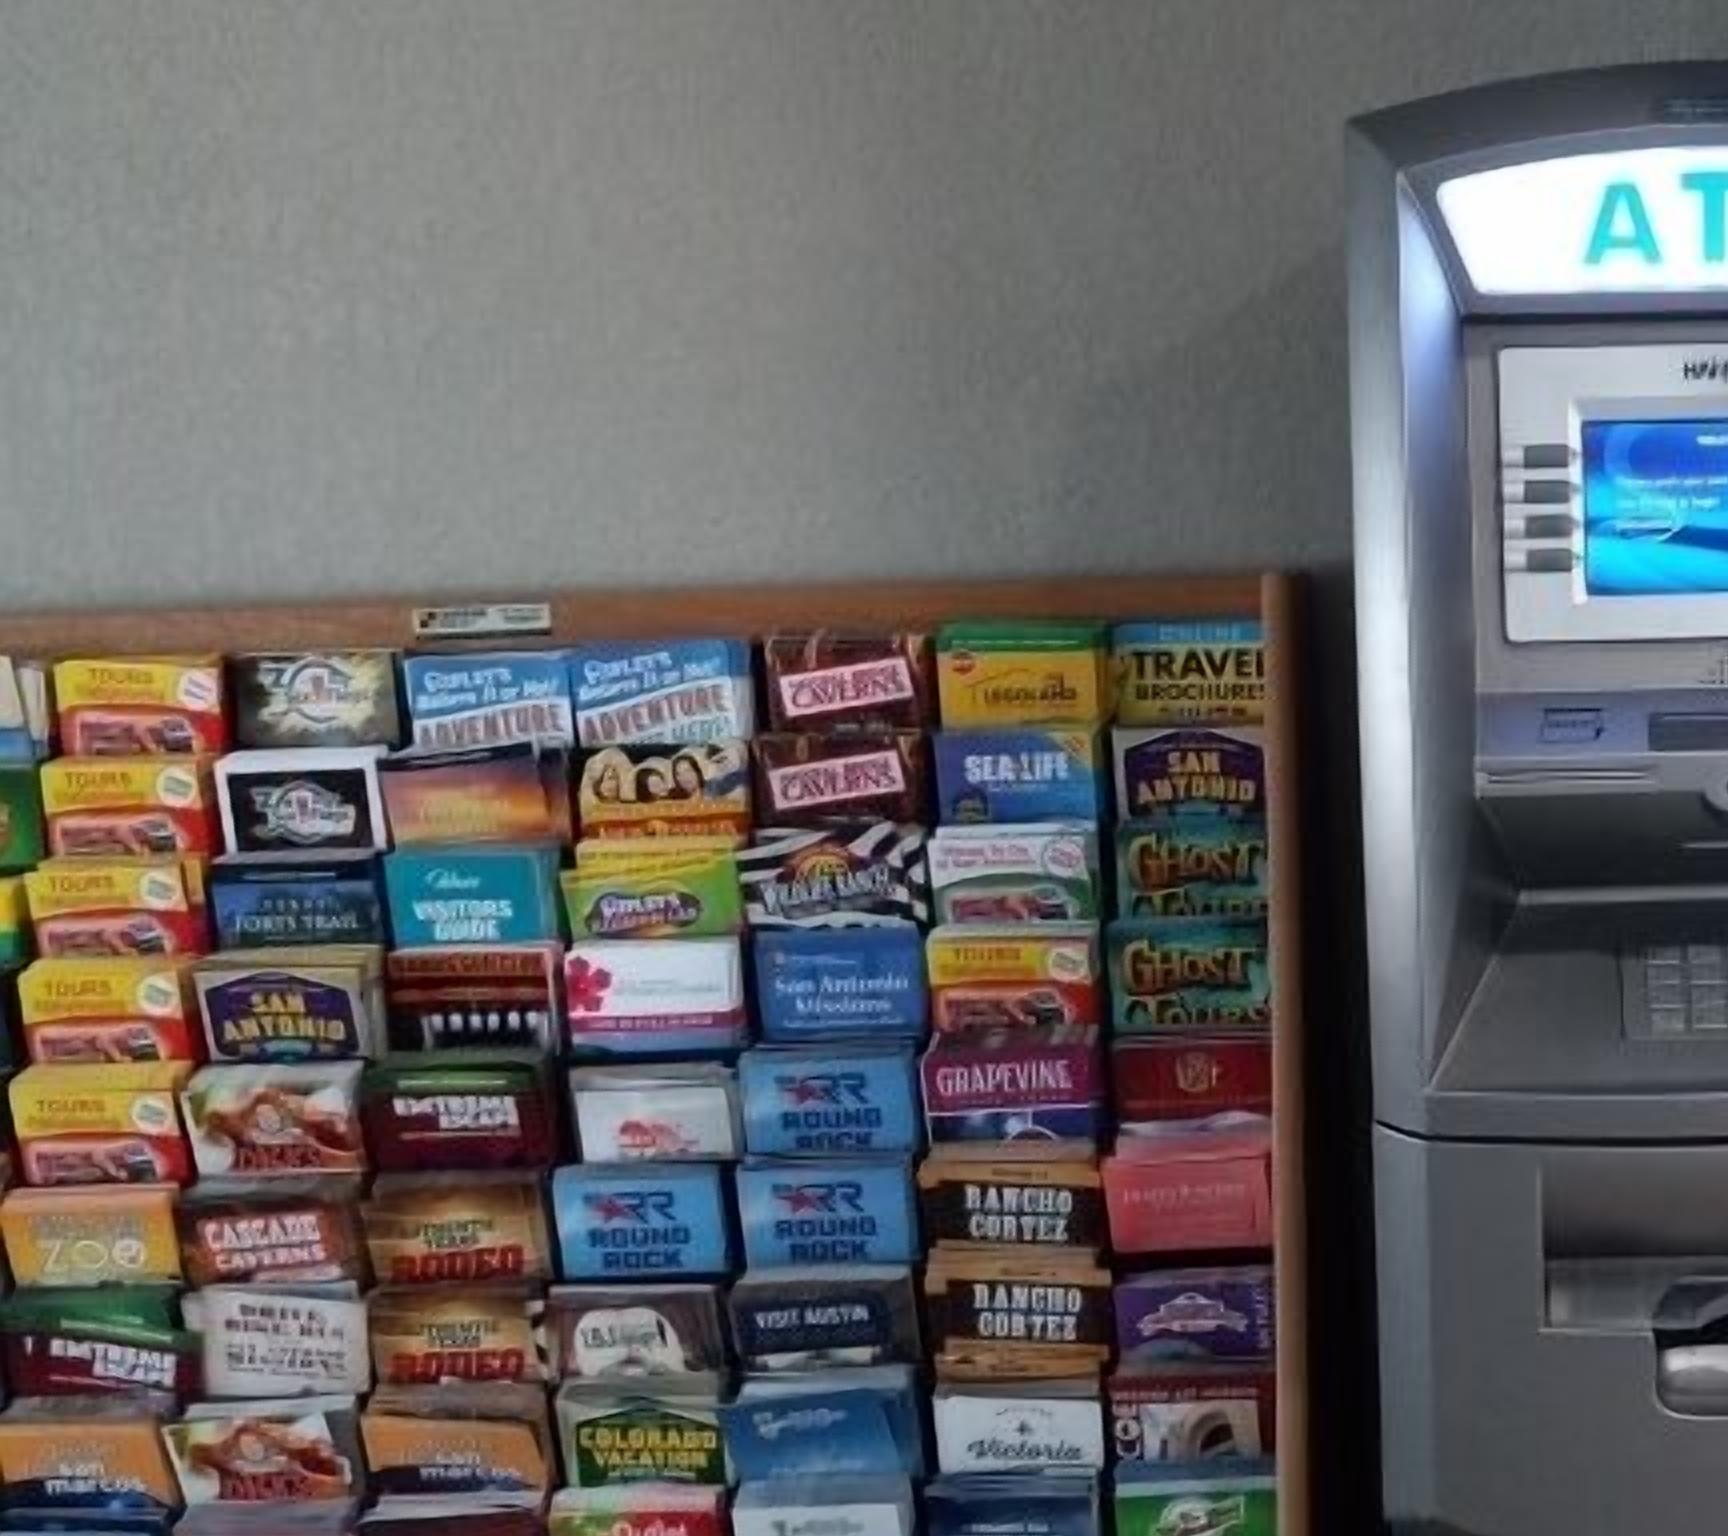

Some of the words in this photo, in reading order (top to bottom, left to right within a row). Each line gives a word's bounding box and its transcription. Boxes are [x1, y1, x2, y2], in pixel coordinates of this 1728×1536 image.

[1168, 751, 1220, 773] SAN
[1137, 774, 1256, 805] ANTONIO
[250, 991, 306, 1013] SAN
[221, 1014, 347, 1043] ANTONIO
[936, 1059, 1074, 1097] GRAPEVINE
[782, 1108, 882, 1129] ROUND
[964, 1184, 1074, 1214] RANCHO
[204, 1215, 321, 1249] CASCADE
[587, 1227, 691, 1248] ROUND
[774, 1216, 877, 1238] ROUND
[969, 1215, 1069, 1242] CORTEZ
[390, 1245, 525, 1282] RODEO
[604, 1250, 683, 1269] ROCK
[789, 1242, 870, 1261] ROCK
[973, 1284, 1083, 1314] RANCHO
[977, 1312, 1078, 1341] CORTEZ
[390, 1348, 525, 1383] RODEO
[579, 1426, 717, 1449] COLORADO
[593, 1449, 709, 1468] VACATION
[967, 1439, 1083, 1462] Victoria
